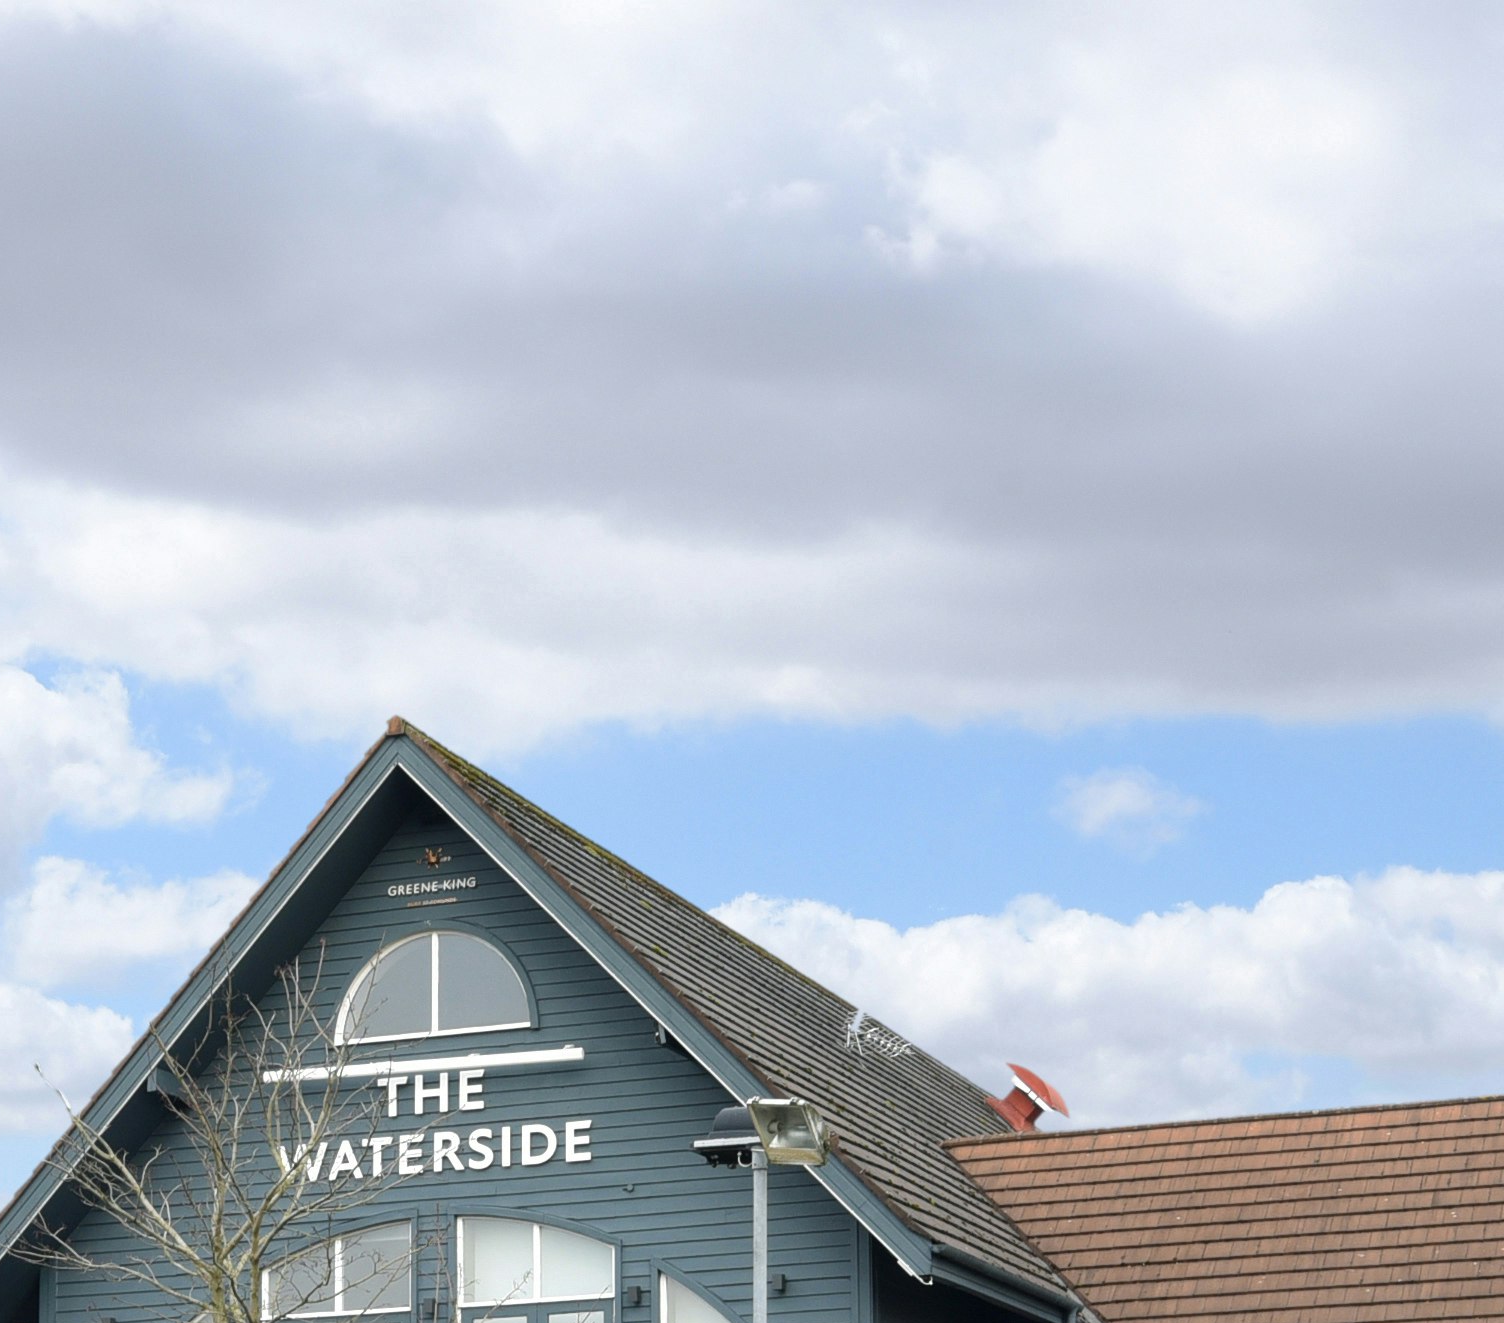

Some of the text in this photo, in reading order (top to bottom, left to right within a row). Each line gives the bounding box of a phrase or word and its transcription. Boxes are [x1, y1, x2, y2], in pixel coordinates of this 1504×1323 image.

[387, 876, 477, 897] GREENE KING
[377, 1068, 485, 1118] THE
[278, 1119, 593, 1182] WATERSIDE
